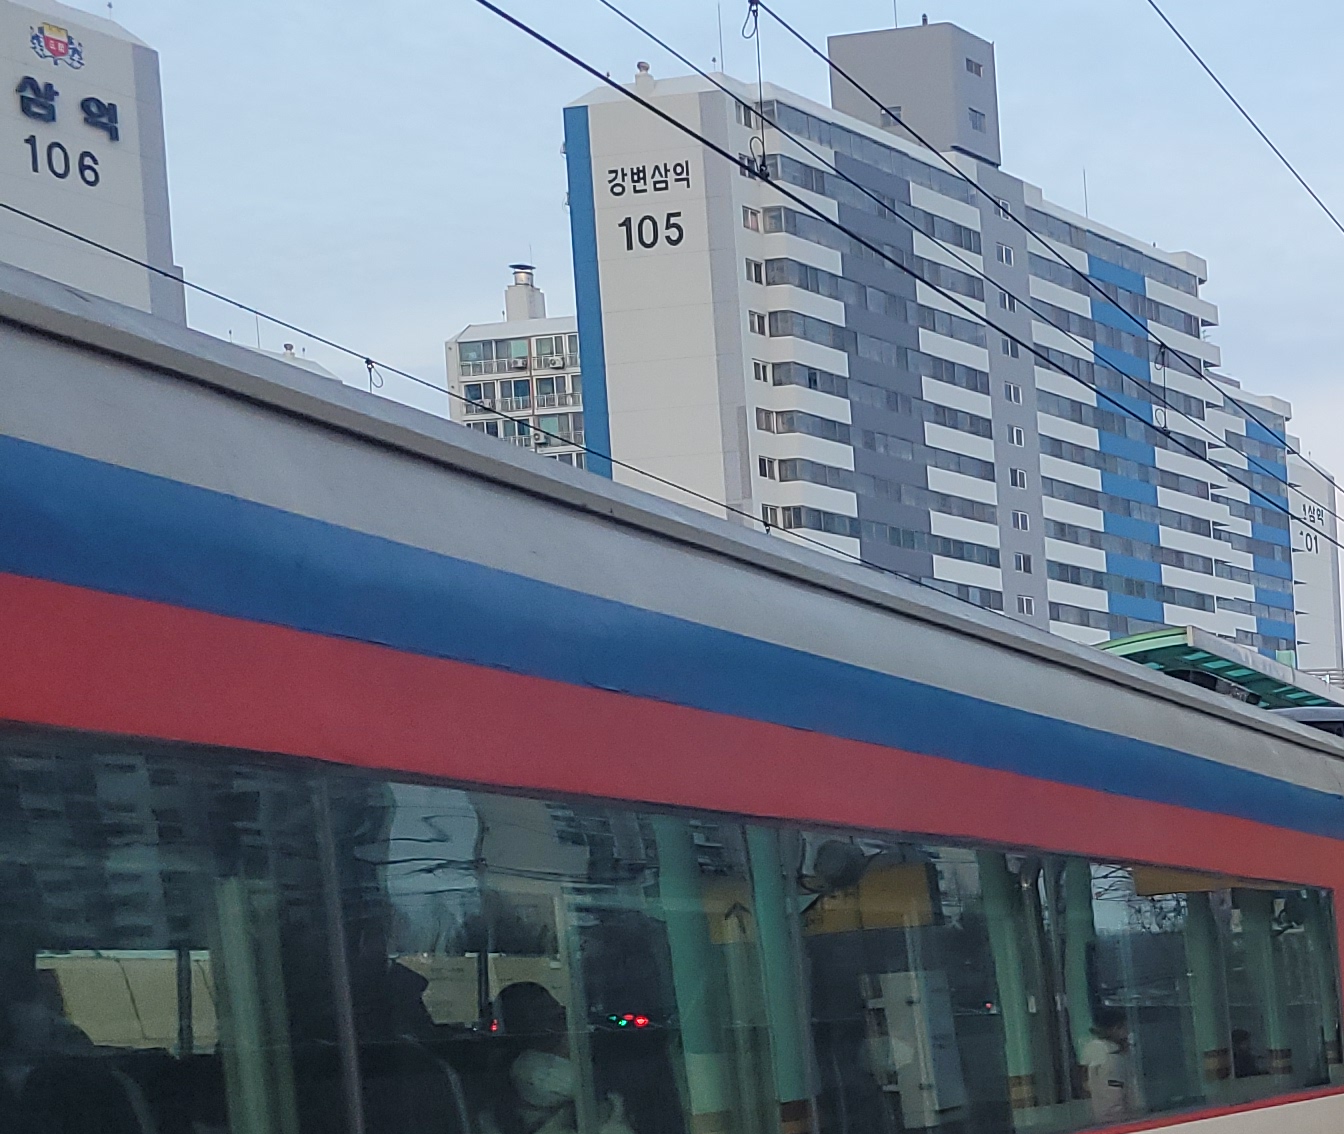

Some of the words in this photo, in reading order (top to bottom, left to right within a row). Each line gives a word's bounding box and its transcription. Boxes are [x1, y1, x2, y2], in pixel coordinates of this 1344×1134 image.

[24, 134, 100, 187] 106
[607, 160, 690, 197] 강변삼익
[617, 211, 684, 251] 105
